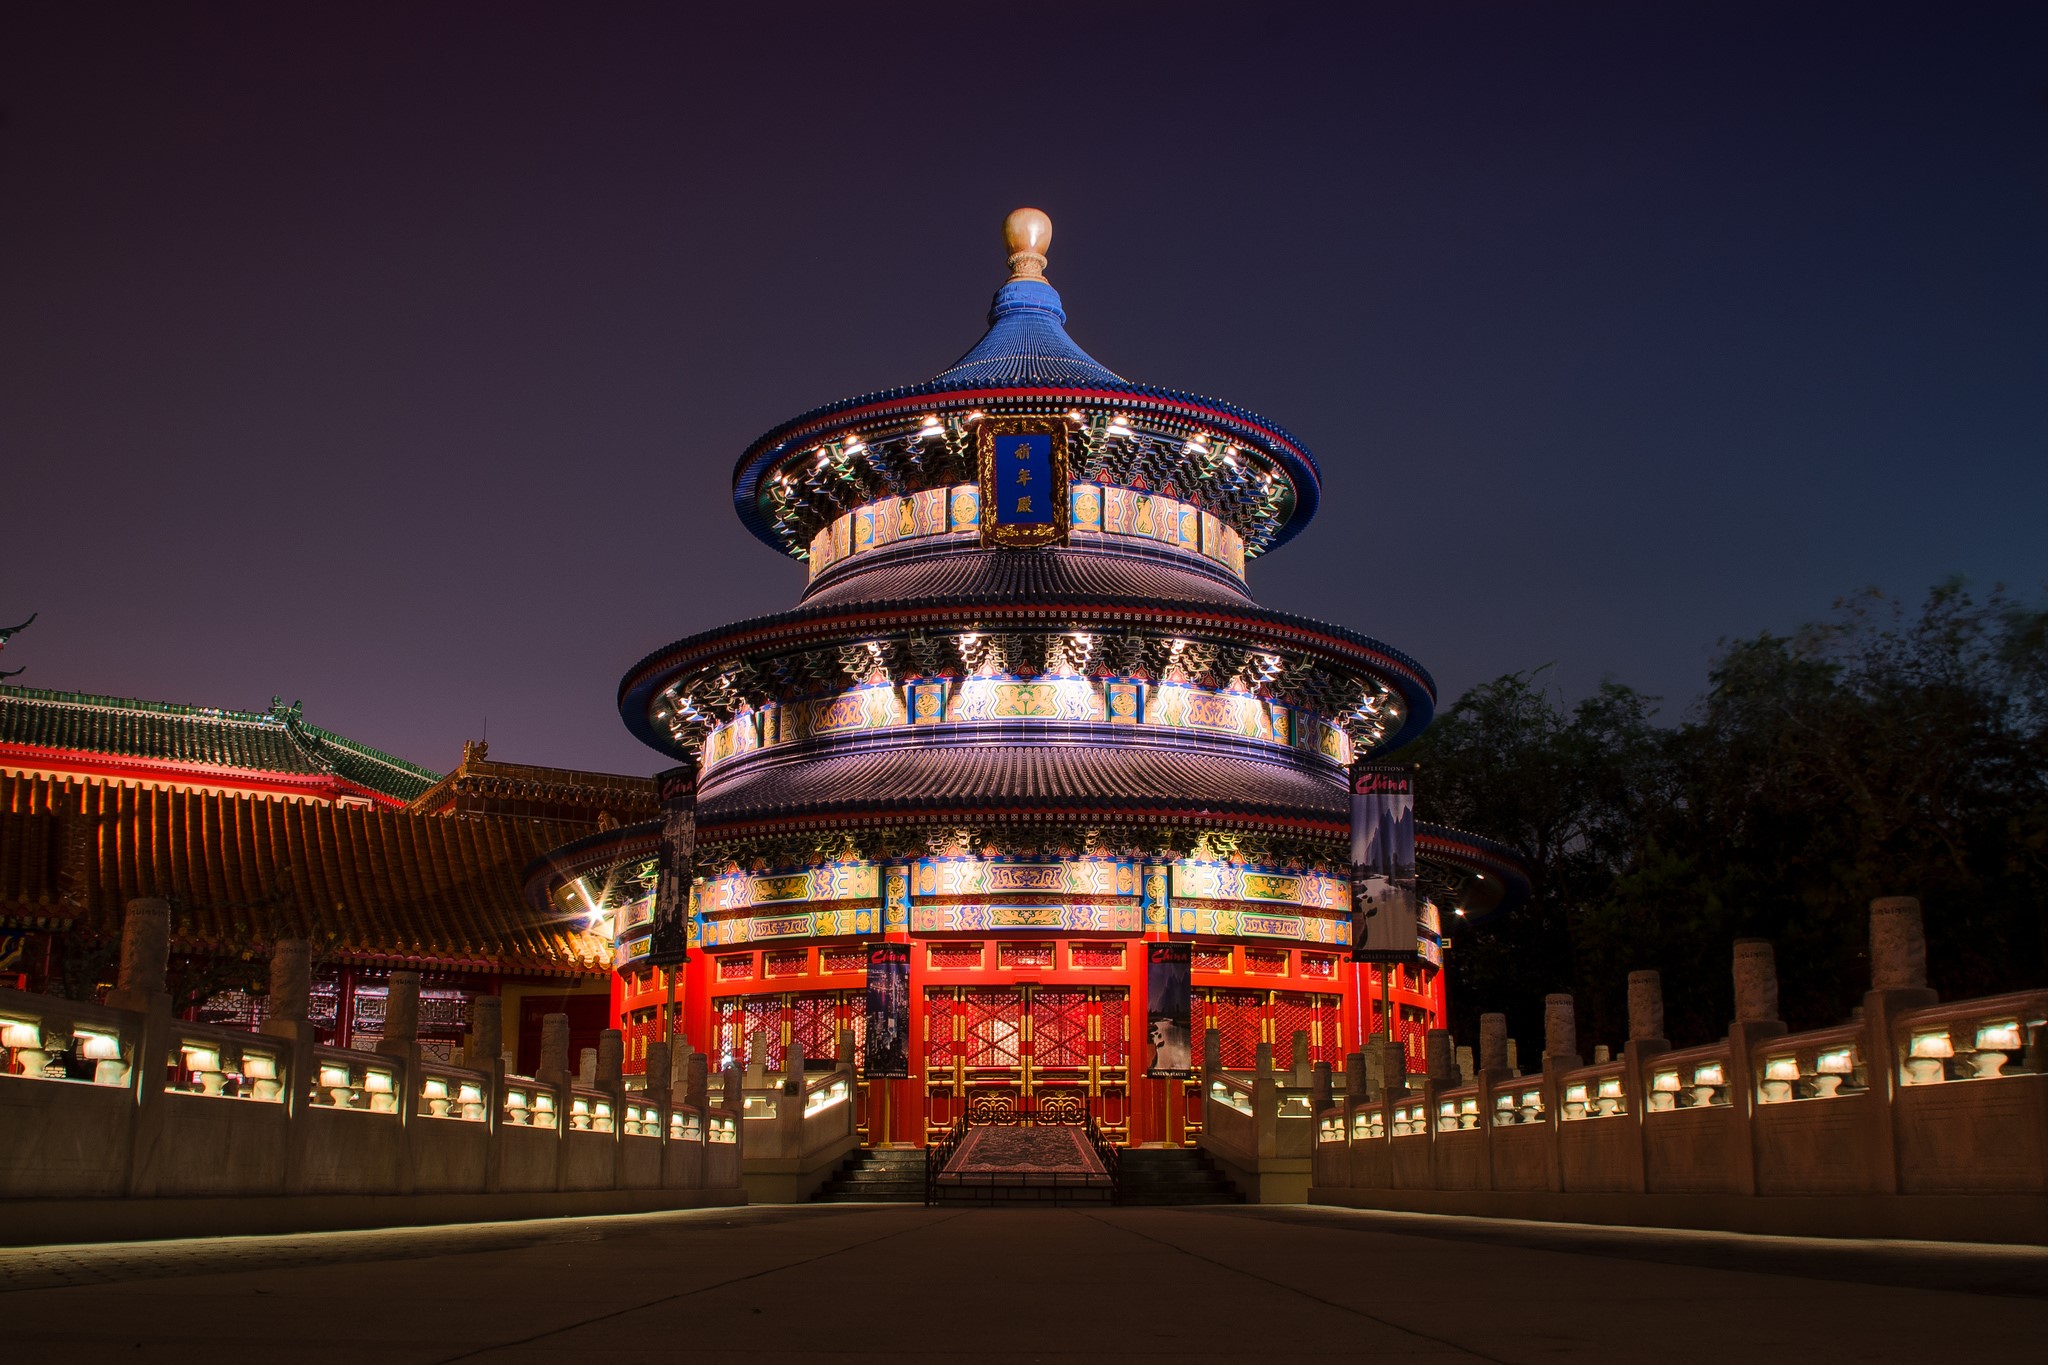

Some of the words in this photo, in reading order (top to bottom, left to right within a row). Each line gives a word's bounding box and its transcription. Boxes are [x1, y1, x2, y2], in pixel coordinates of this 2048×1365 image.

[1355, 773, 1408, 794] China
[871, 949, 907, 964] China
[1151, 948, 1187, 963] China
